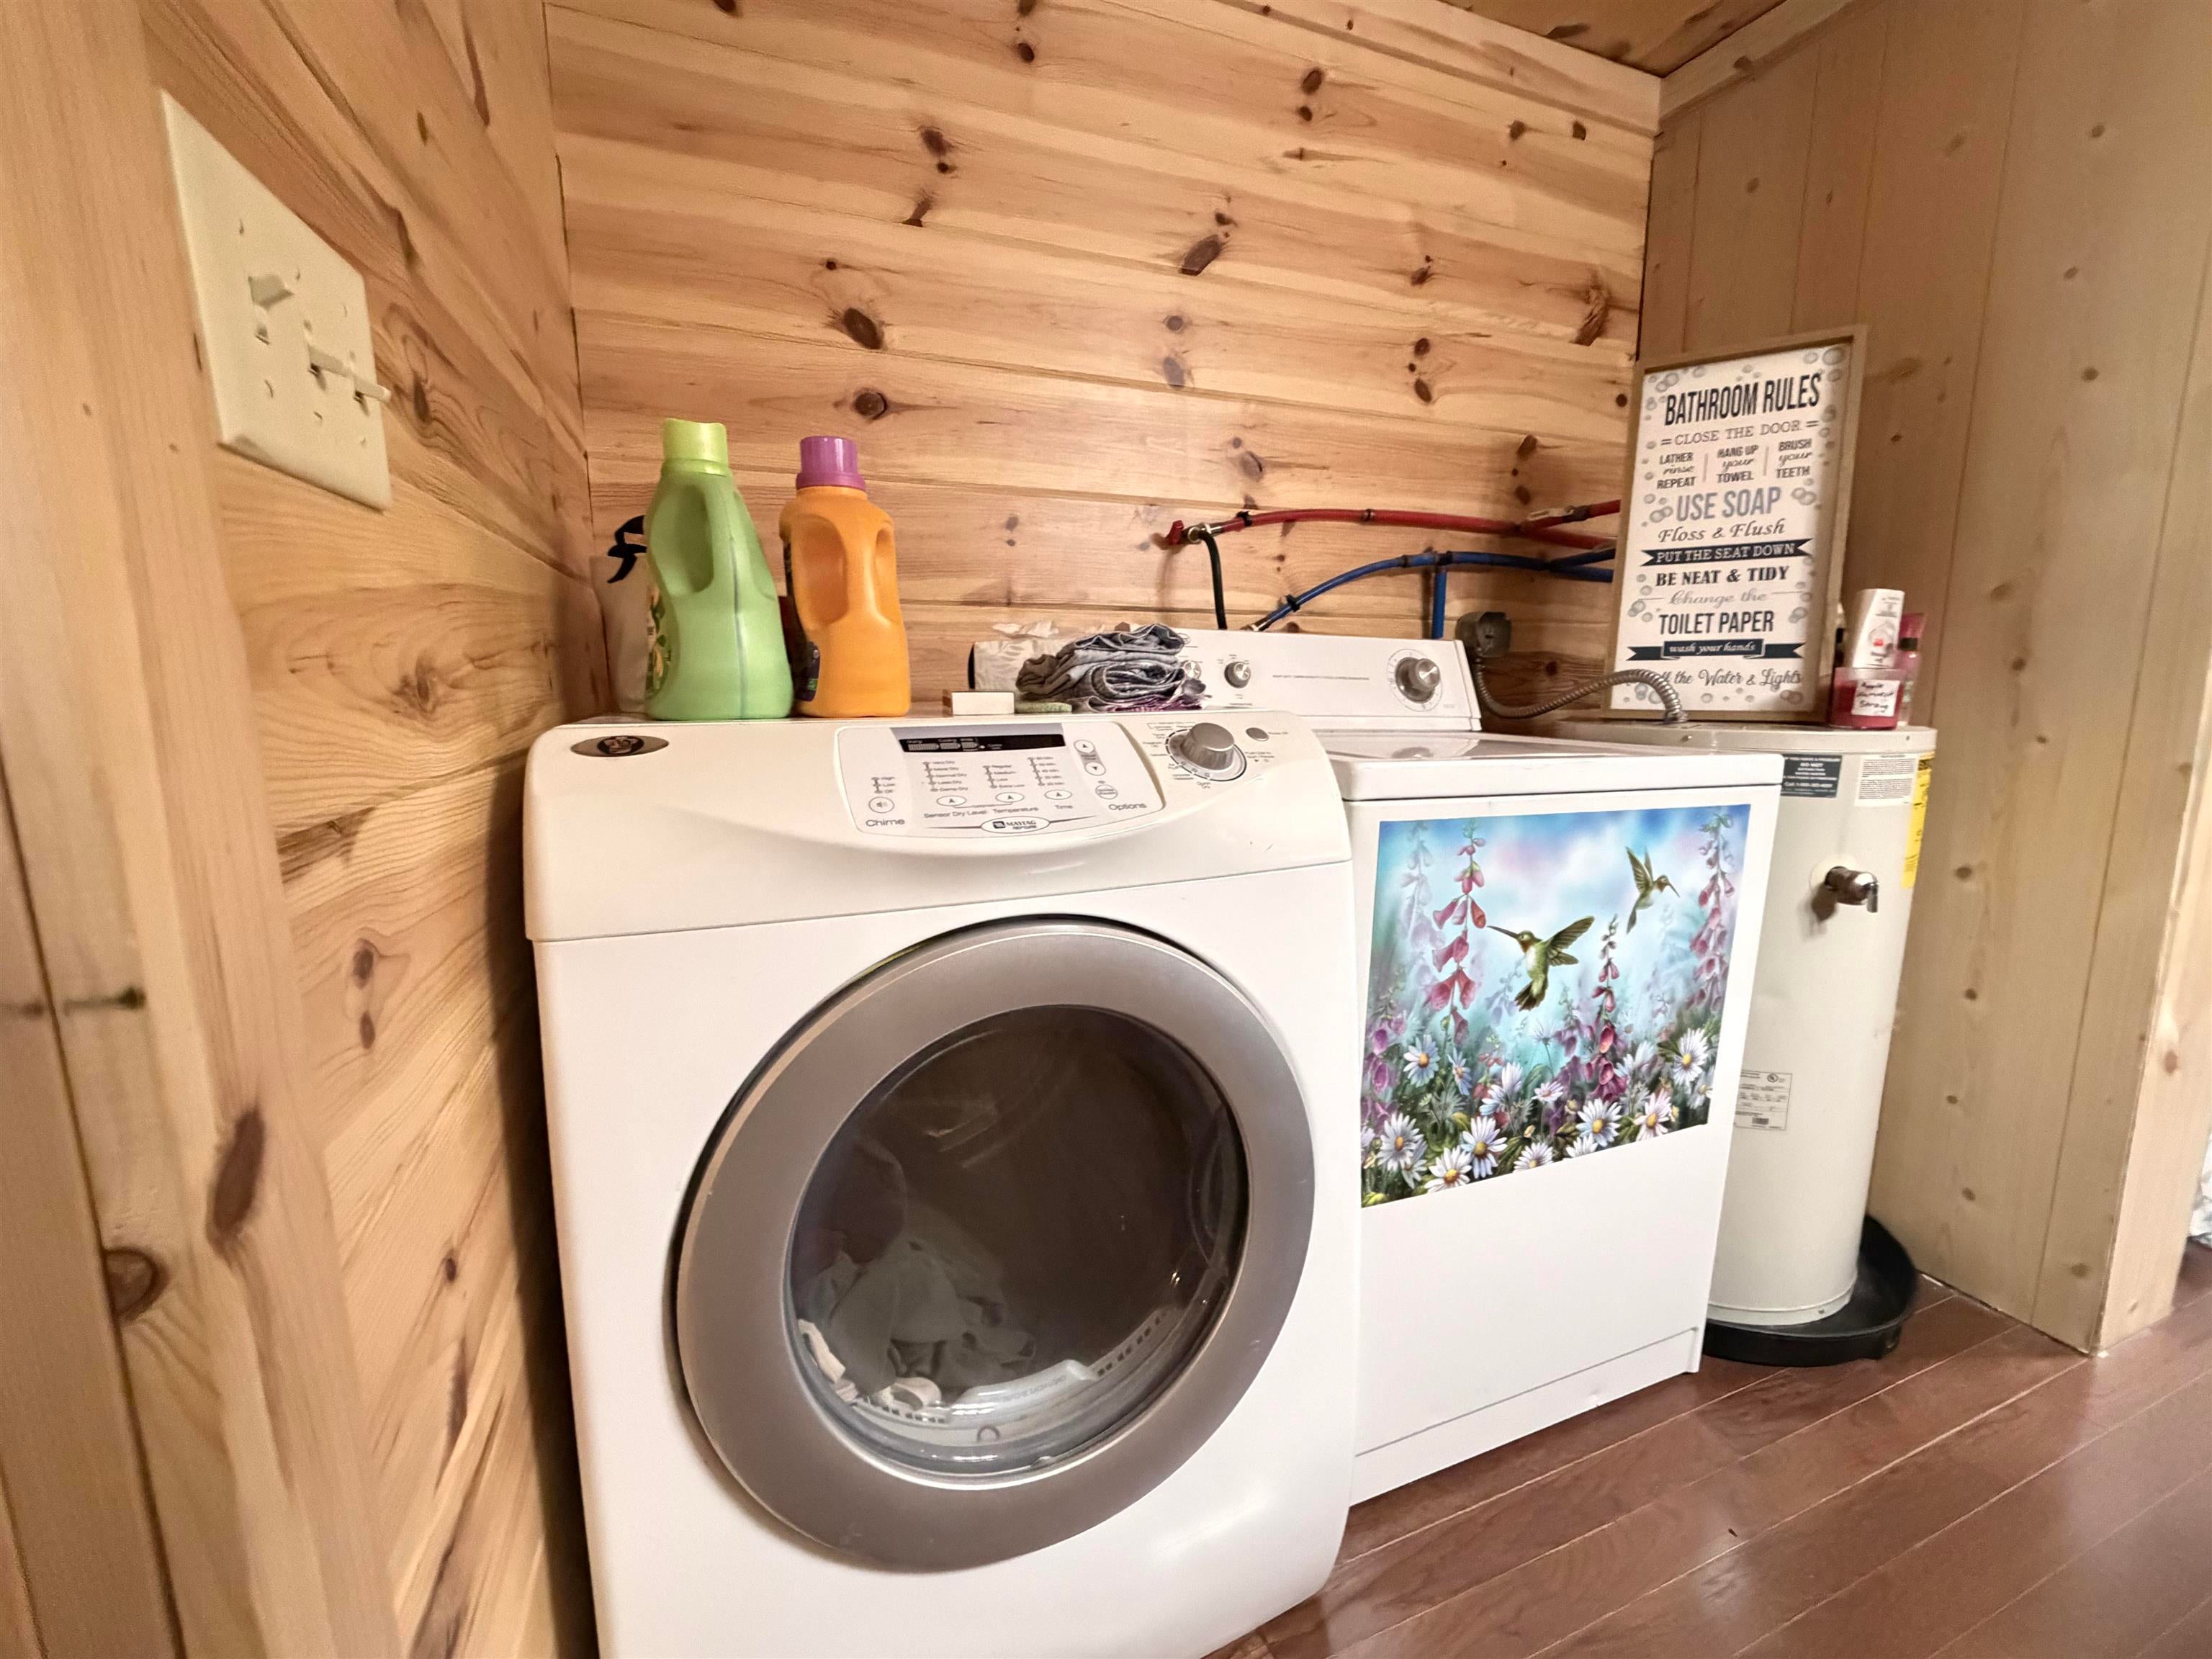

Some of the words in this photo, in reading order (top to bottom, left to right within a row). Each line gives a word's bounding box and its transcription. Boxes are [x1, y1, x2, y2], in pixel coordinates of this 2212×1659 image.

[1664, 382, 1758, 426] BATHROOM
[1763, 372, 1822, 413] RULES
[1675, 431, 1719, 445] CLOSE
[1726, 426, 1754, 439] THE
[1761, 420, 1802, 435] DOOR
[1717, 446, 1743, 458] HANG
[1745, 445, 1758, 454] UP
[1779, 438, 1812, 451] BRUSH
[1659, 452, 1694, 464] LATHER
[1779, 452, 1812, 467] your
[1663, 464, 1694, 475] rinse
[1722, 459, 1755, 472] your
[1776, 466, 1811, 479] TEETH
[1657, 476, 1697, 489] REPEAT
[1717, 471, 1754, 483] TOWEL
[1676, 492, 1718, 521] USE
[1722, 486, 1781, 518] SOAP
[1658, 526, 1707, 542] Floss
[1712, 527, 1724, 538] &
[1730, 518, 1786, 537] Flush
[1656, 552, 1681, 563] PUT
[1684, 549, 1712, 561] THE
[1714, 545, 1749, 559] SEAT
[1752, 542, 1796, 557] DOWN
[1655, 572, 1678, 586] BE
[1681, 570, 1721, 585] NEAT
[1727, 568, 1740, 583] &
[1748, 565, 1790, 582] TIDY
[1668, 590, 1735, 608] Change
[1740, 588, 1766, 602] the
[1659, 613, 1714, 635] TOILET
[1718, 610, 1775, 633] PAPER
[1669, 642, 1696, 652] wash
[1696, 645, 1722, 655] your
[1723, 641, 1756, 652] hands
[1673, 670, 1694, 684] the
[1699, 668, 1743, 686] Water
[1746, 675, 1757, 685] &
[1759, 668, 1802, 690] Lights
[1108, 802, 1147, 811] Options
[866, 818, 906, 827] Chime
